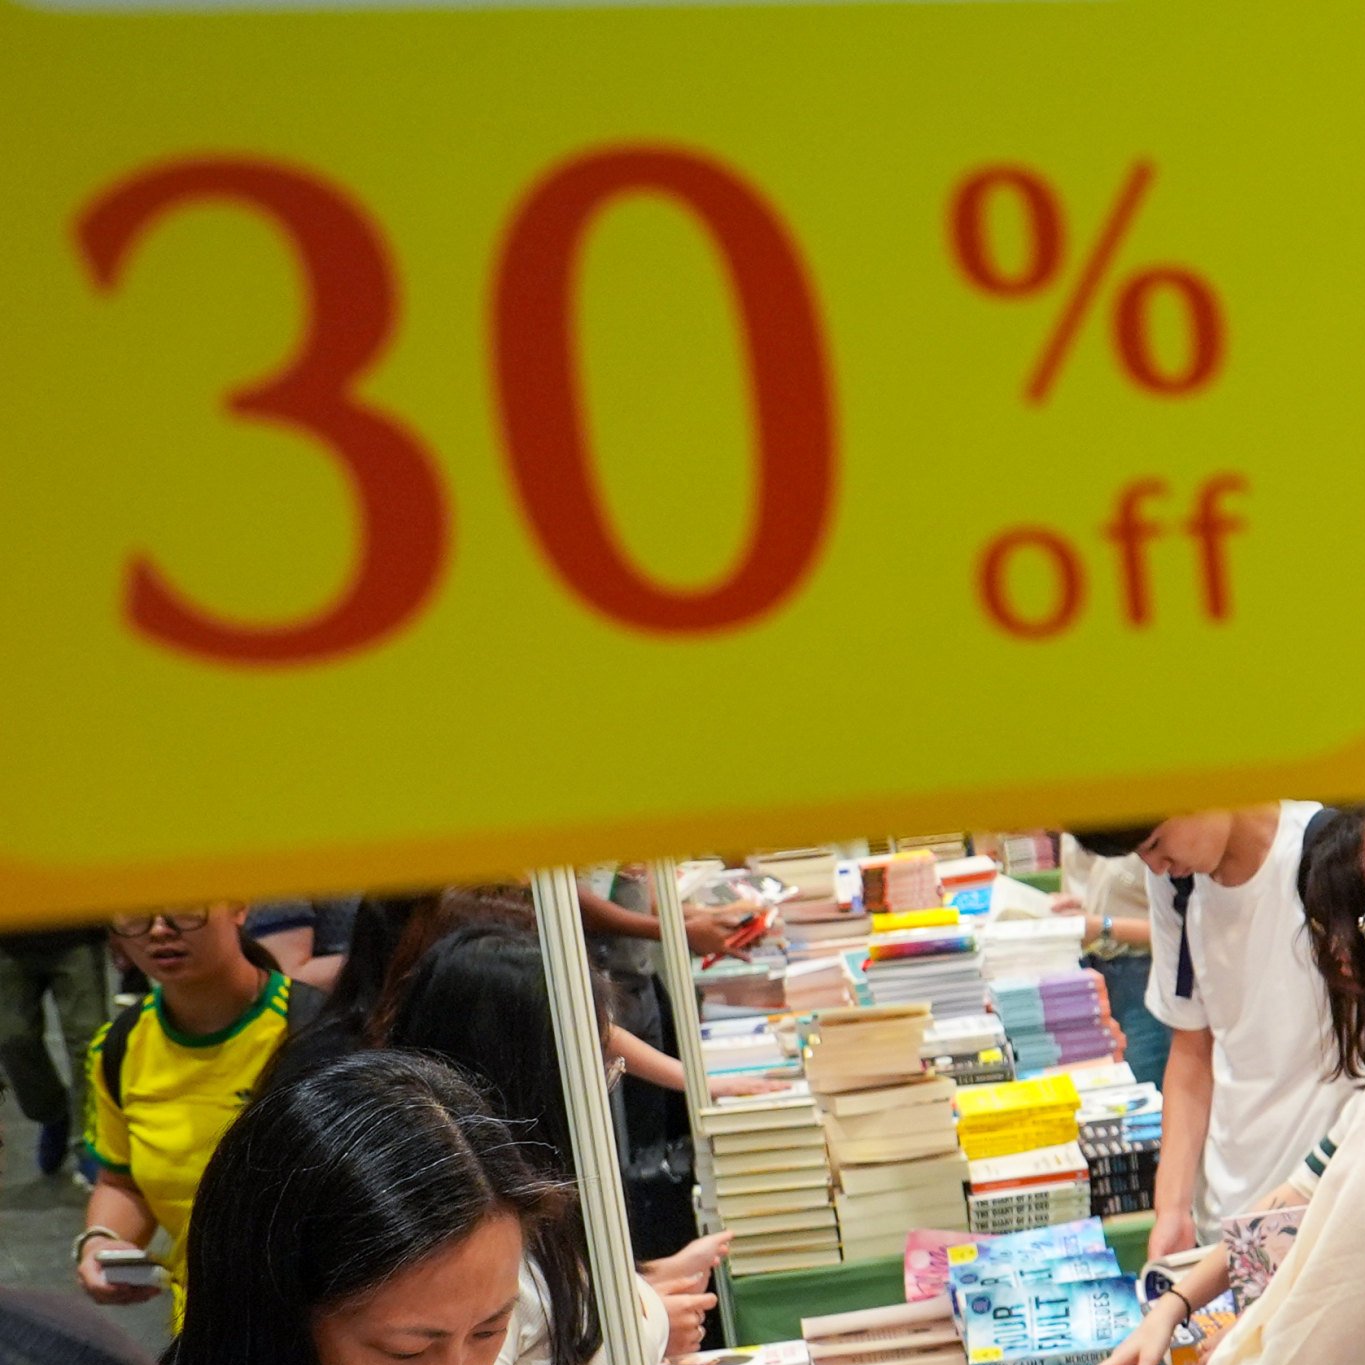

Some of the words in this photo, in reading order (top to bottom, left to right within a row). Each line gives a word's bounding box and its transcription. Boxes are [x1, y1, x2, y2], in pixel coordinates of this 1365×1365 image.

[70, 139, 841, 671] 30
[945, 157, 1228, 405] %
[975, 472, 1252, 642] off
